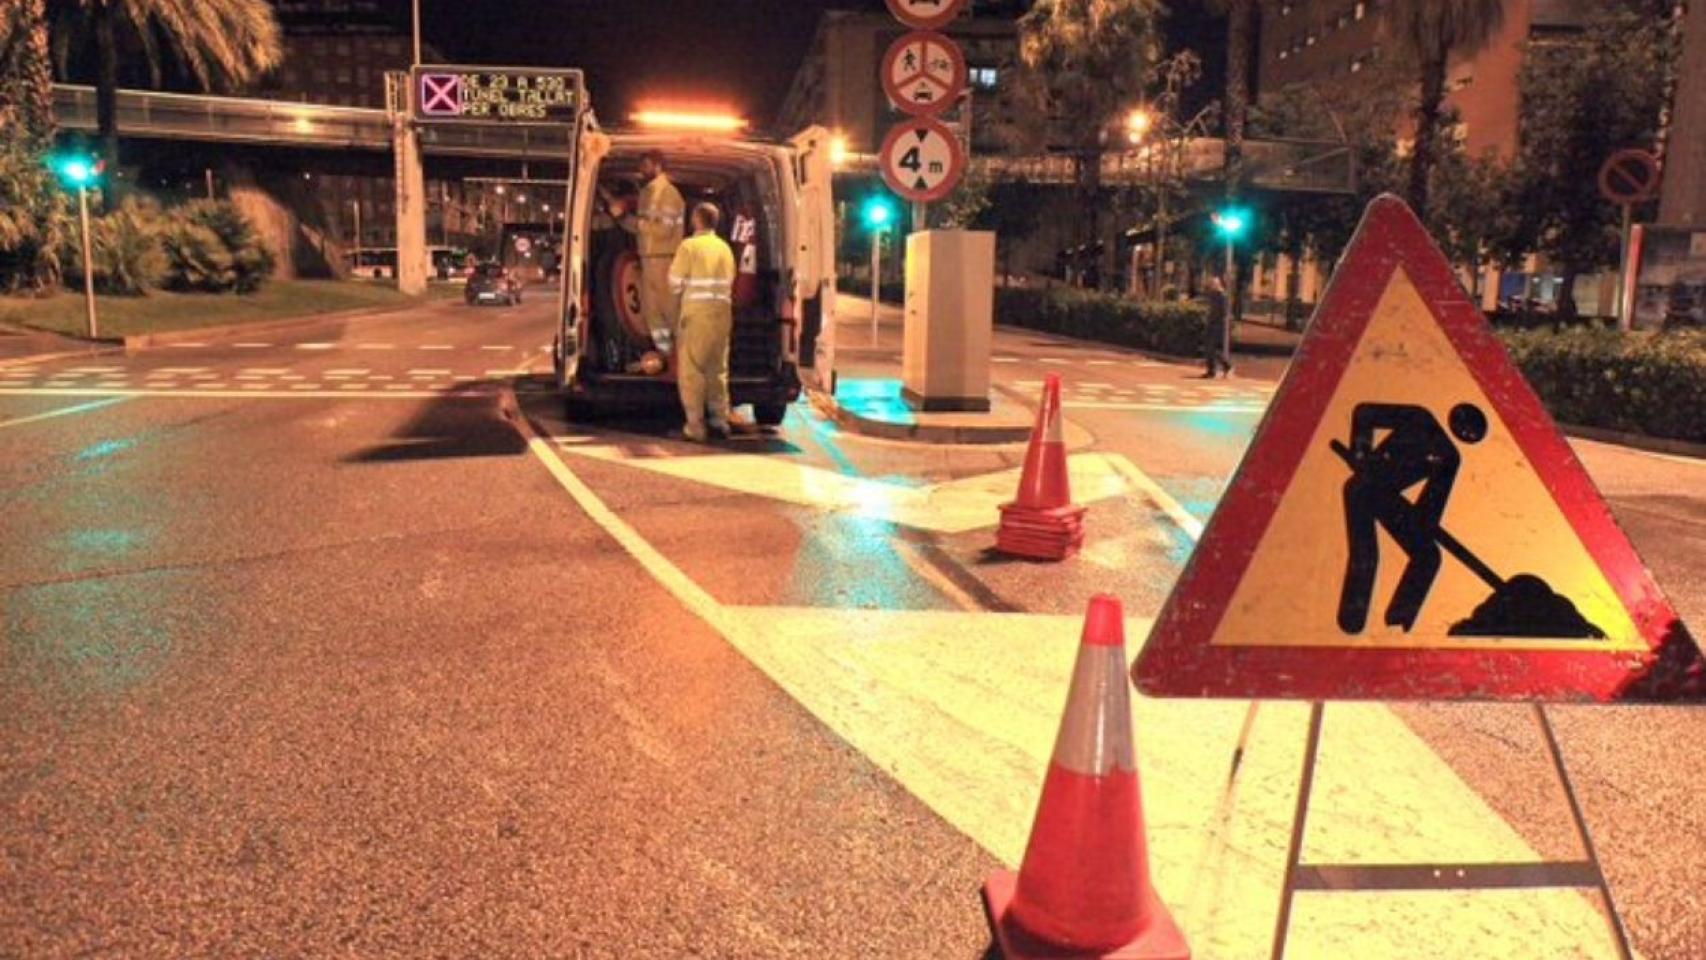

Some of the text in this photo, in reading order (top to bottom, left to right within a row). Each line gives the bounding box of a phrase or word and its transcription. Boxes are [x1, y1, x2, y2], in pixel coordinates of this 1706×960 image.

[461, 74, 480, 89] DE
[517, 76, 528, 90] A
[462, 89, 575, 105] TUNEL TALLAT
[462, 103, 546, 118] PER OBRES
[898, 146, 943, 173] 4 m
